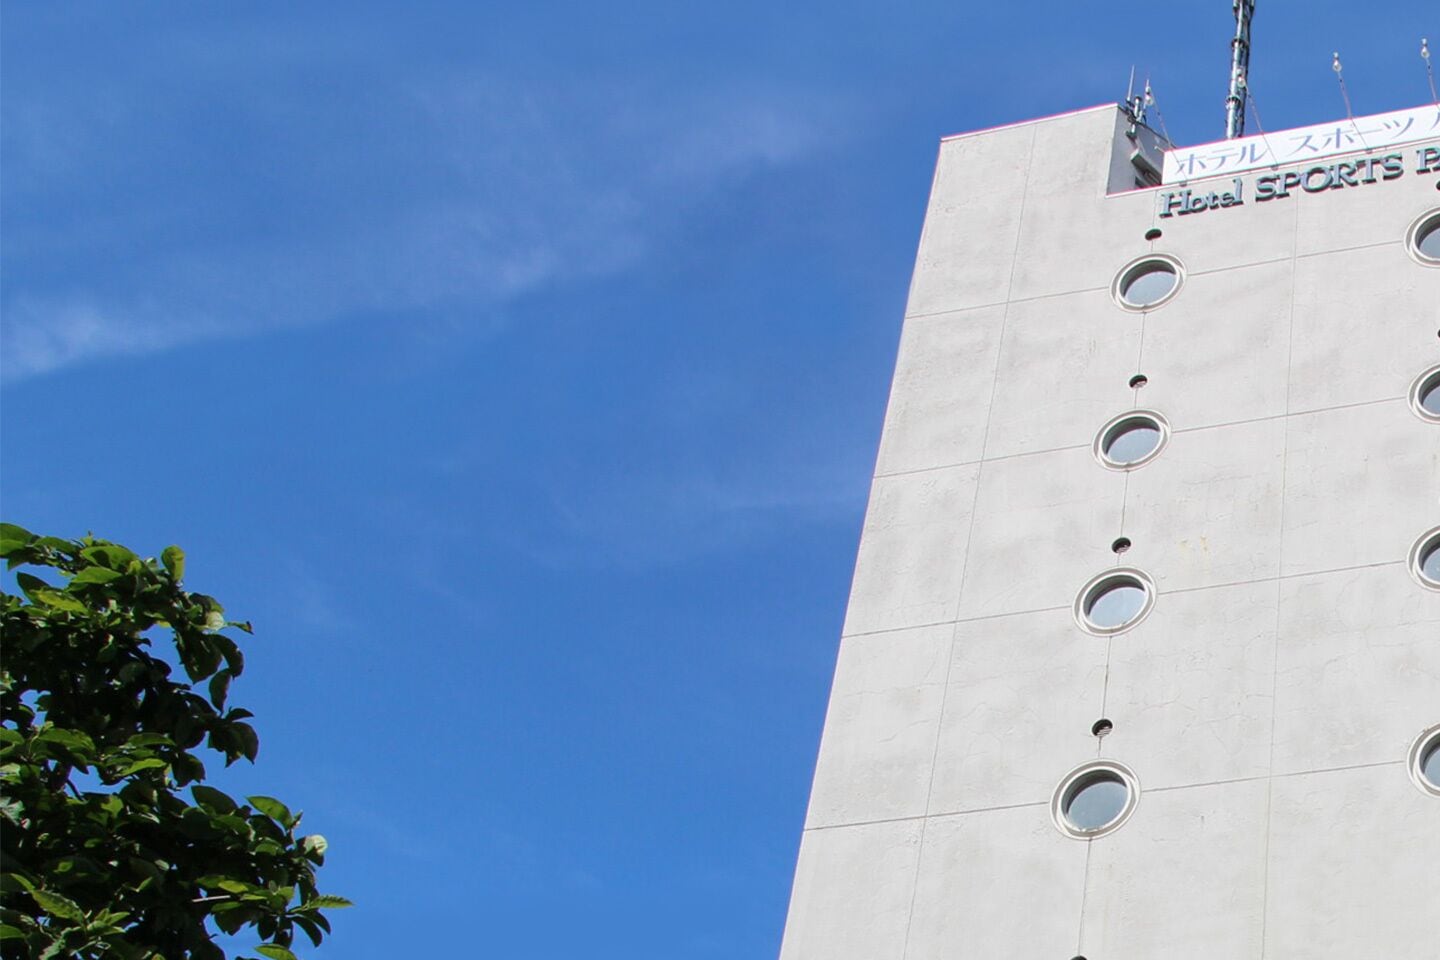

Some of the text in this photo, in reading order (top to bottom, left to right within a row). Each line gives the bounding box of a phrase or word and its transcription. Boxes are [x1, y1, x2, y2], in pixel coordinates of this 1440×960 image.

[1174, 142, 1268, 176] ホテル
[1286, 116, 1415, 158] スポーツ
[1159, 176, 1244, 218] Hotel
[1255, 152, 1404, 202] SPORTS
